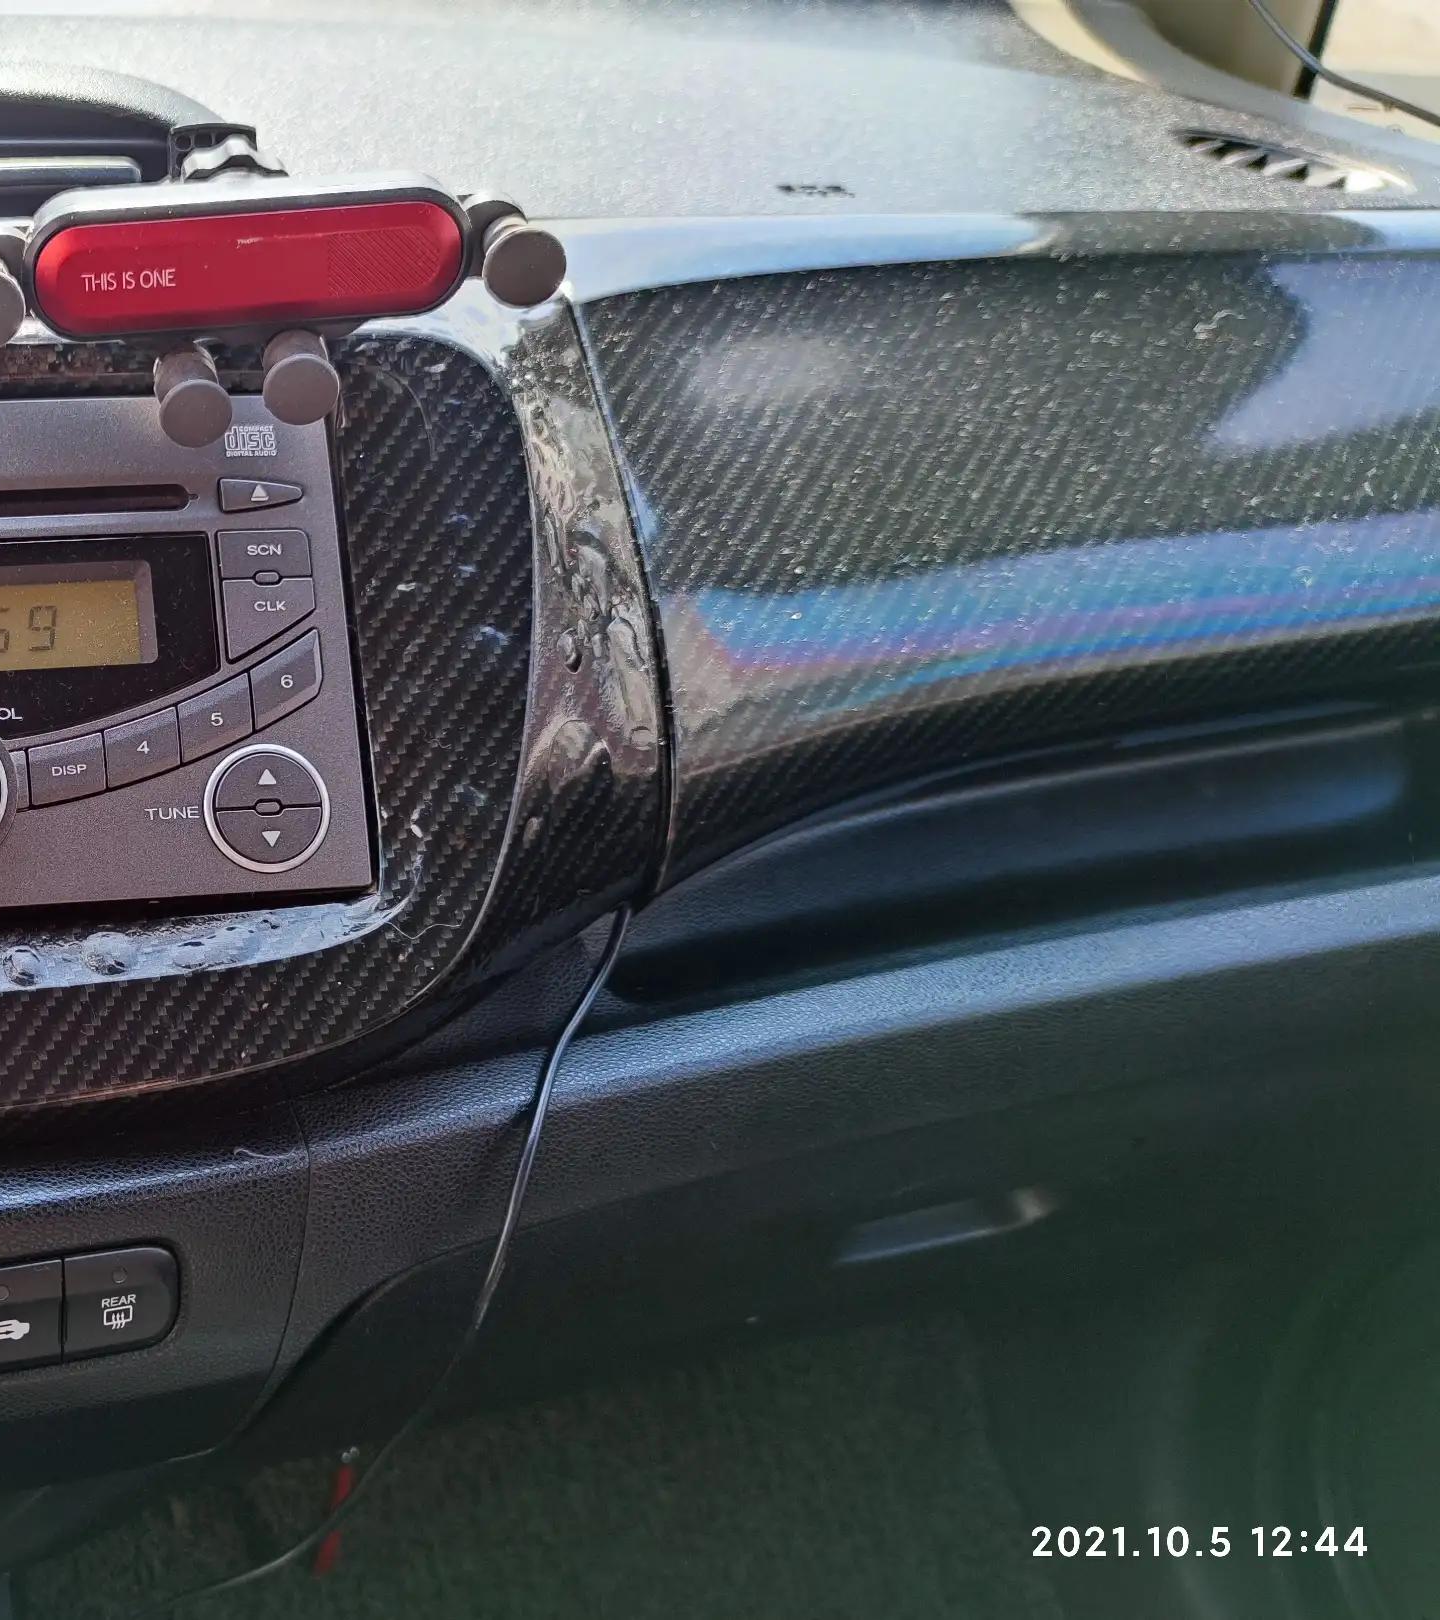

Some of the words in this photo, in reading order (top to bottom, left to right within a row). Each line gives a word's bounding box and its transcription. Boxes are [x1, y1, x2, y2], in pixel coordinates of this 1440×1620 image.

[81, 273, 117, 292] THIS
[122, 271, 136, 290] IS
[139, 268, 177, 289] ONE
[246, 543, 283, 556] SCN
[253, 600, 287, 612] CLK
[280, 674, 294, 689] 6
[210, 712, 224, 727] 5
[136, 740, 150, 755] 4
[51, 763, 88, 777] DISP
[145, 806, 201, 821] TUNE
[101, 1294, 137, 1309] REAR
